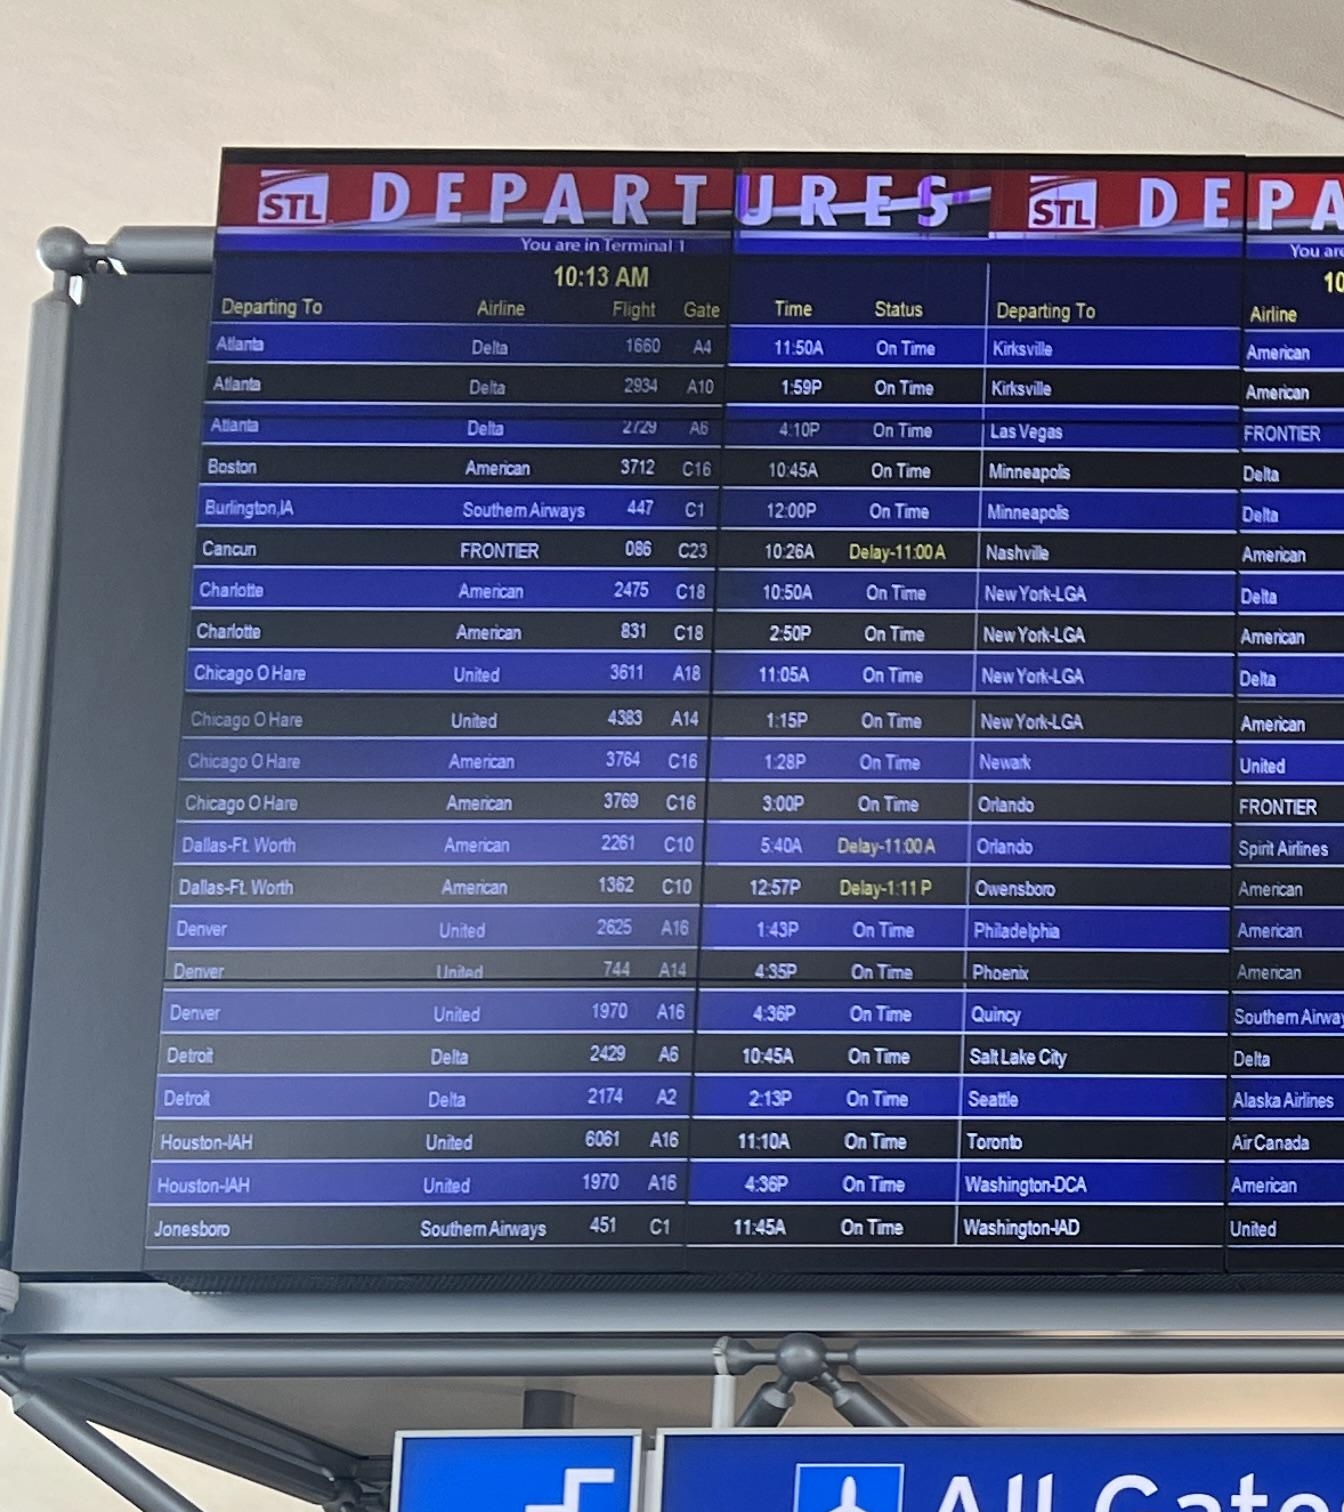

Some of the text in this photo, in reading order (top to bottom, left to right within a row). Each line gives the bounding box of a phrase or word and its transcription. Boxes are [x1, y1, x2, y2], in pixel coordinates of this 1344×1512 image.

[264, 172, 950, 226] STL DEPARTURES
[1033, 202, 1091, 226] STL
[521, 238, 685, 252] You are in Terminal 1
[554, 266, 649, 289] 10:13 AM
[221, 298, 924, 322] Departing To Airline Flight Gate Time Status
[216, 335, 936, 356] Atlanta Delta 1660 A4 11:50A On Time
[202, 541, 257, 557] Cancun
[460, 543, 540, 560] FRONTIER
[625, 541, 652, 558] 086
[678, 542, 709, 561] C23
[765, 543, 815, 560] 10:26A
[850, 543, 933, 563] Delay-11:00
[985, 586, 1018, 603] New
[1020, 586, 1086, 603] York-LGA
[1241, 589, 1278, 606] Delta
[167, 1046, 910, 1066] Detroit Delta 2429 A6 10:45A On Time
